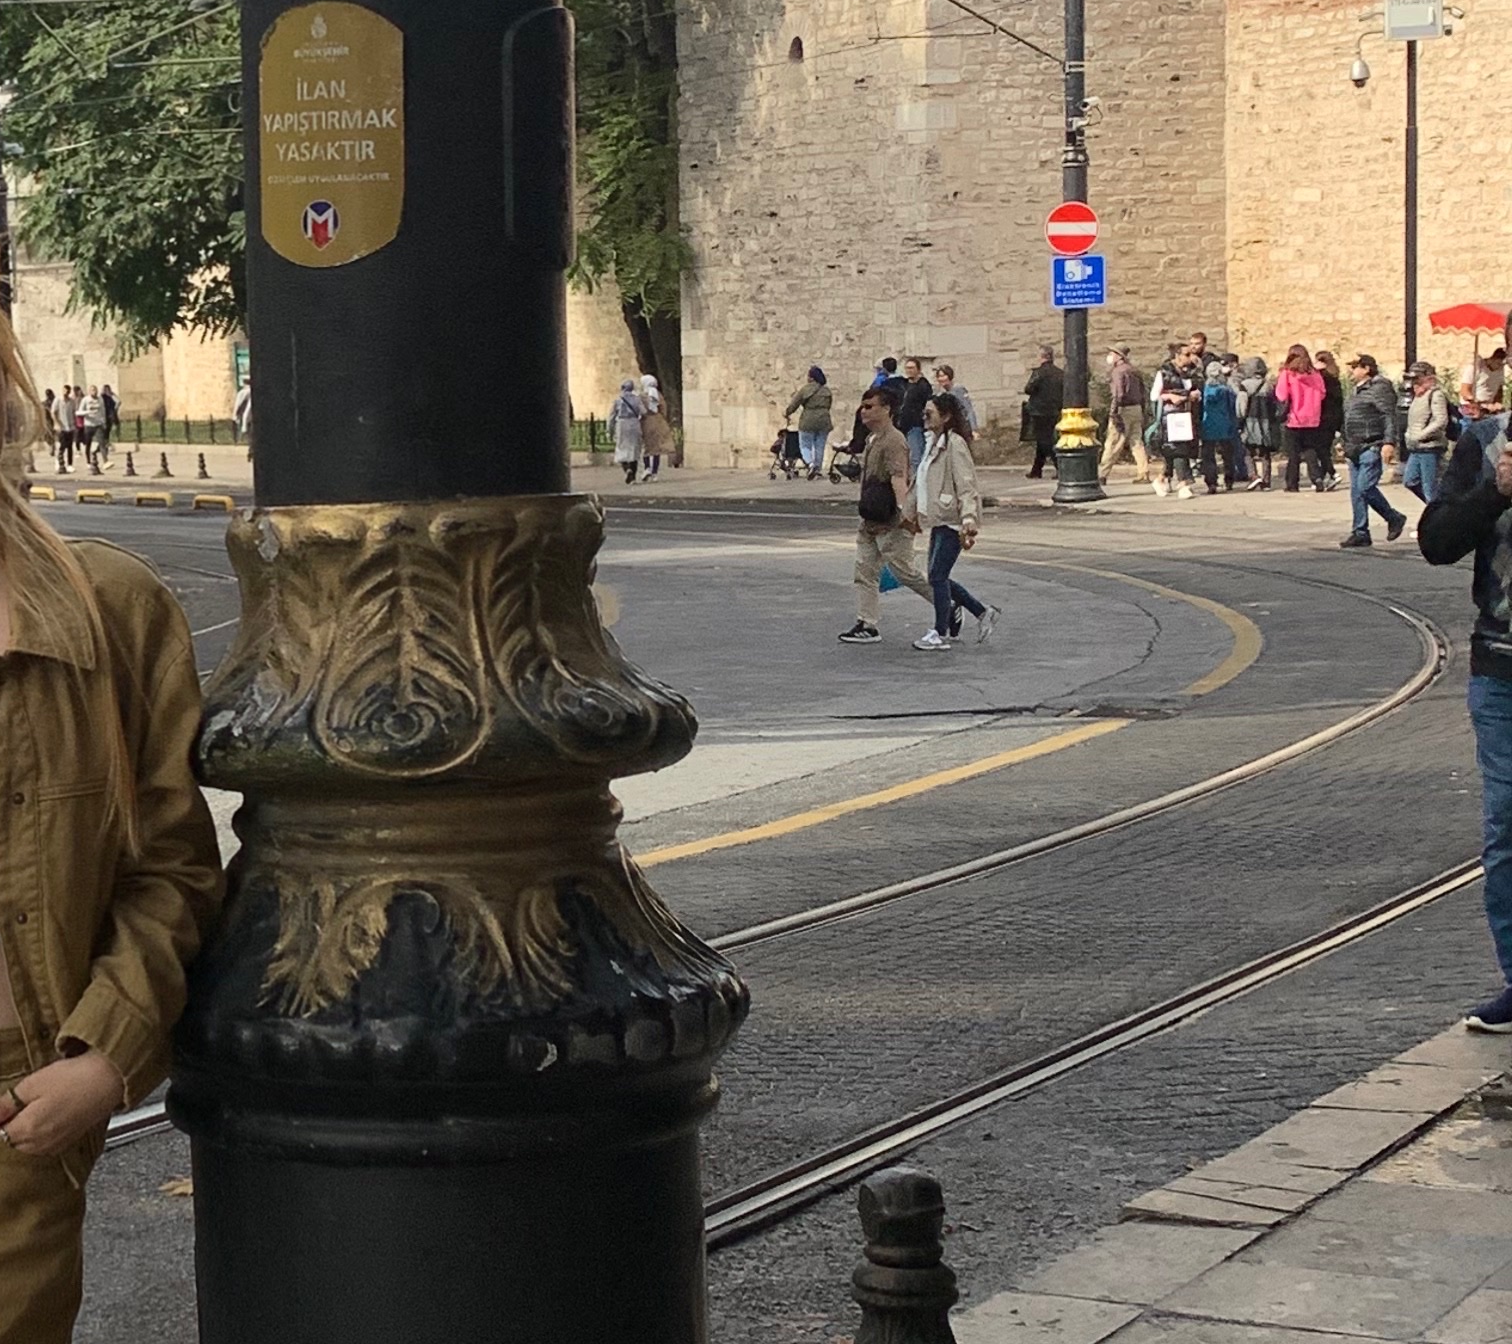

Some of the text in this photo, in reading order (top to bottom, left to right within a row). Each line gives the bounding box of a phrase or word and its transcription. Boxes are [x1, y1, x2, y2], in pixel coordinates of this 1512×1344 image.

[296, 77, 346, 101] İLAN
[263, 108, 397, 136] YAPIŞTIRMAK
[275, 140, 375, 162] YASAKTIR
